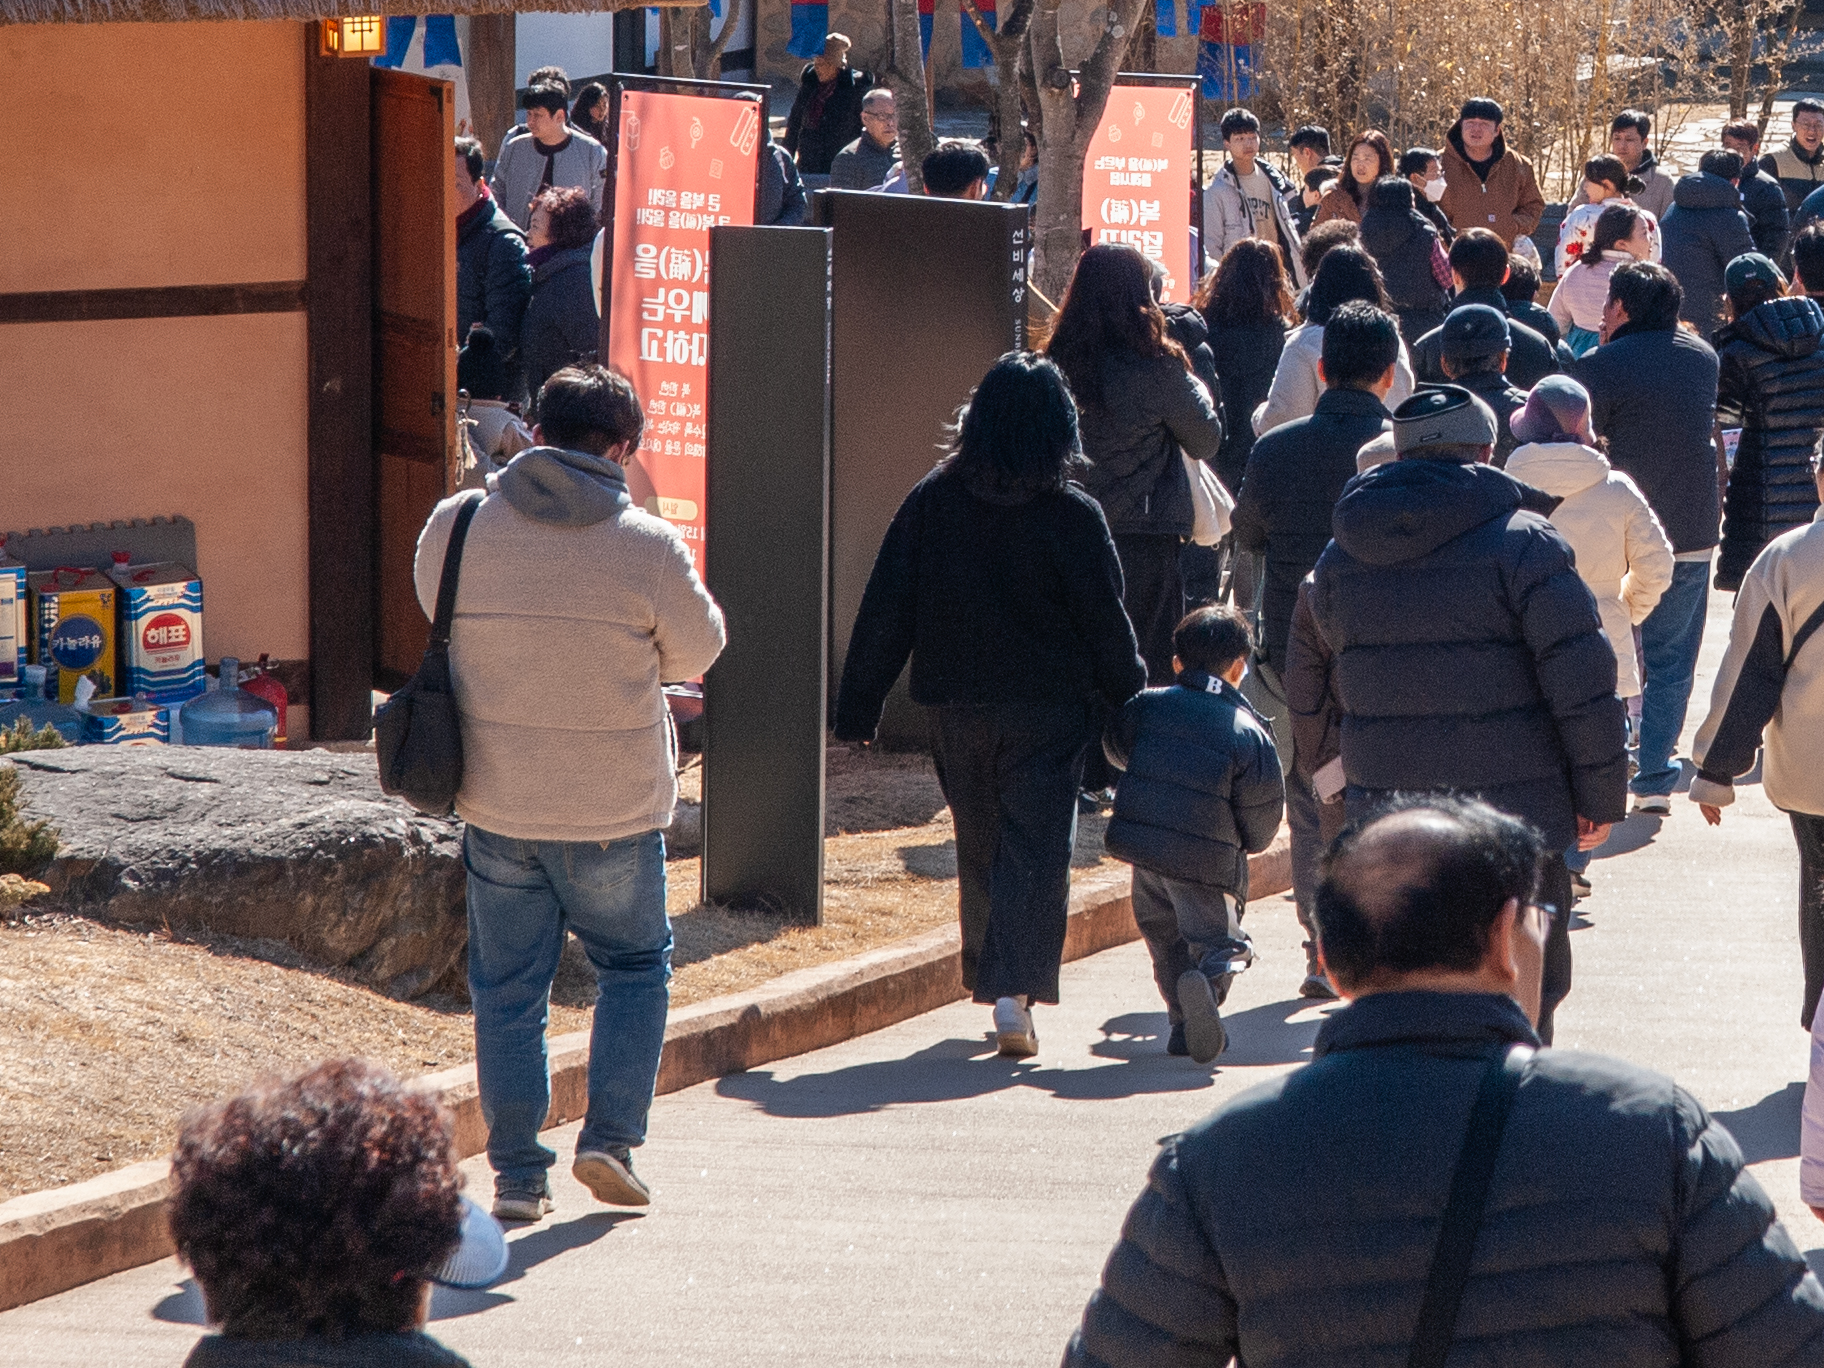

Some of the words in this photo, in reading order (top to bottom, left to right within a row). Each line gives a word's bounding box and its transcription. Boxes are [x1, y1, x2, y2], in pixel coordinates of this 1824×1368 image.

[1012, 228, 1025, 303] 선비세상
[146, 625, 187, 645] 해표
[1206, 674, 1223, 694] B
